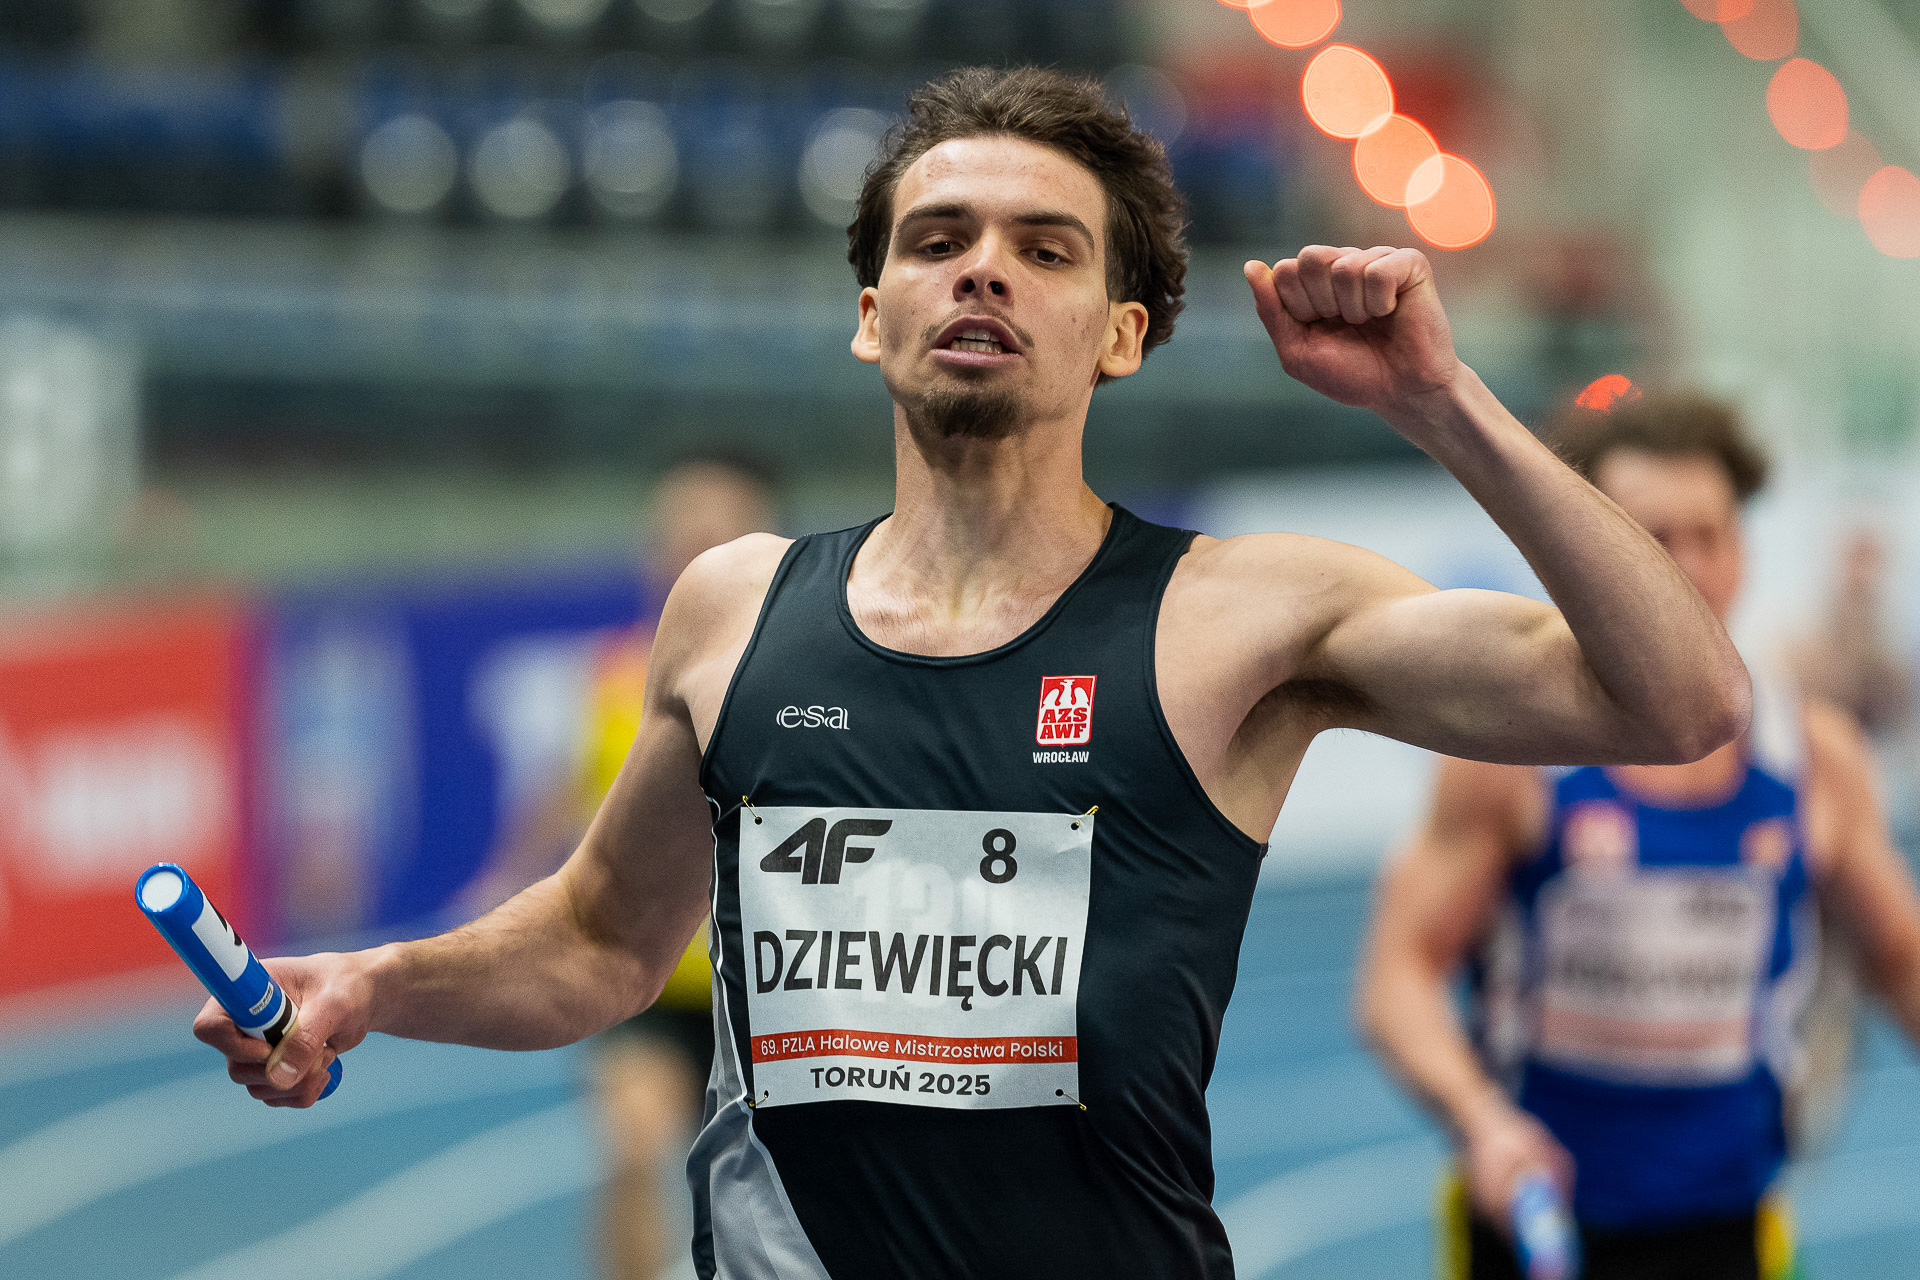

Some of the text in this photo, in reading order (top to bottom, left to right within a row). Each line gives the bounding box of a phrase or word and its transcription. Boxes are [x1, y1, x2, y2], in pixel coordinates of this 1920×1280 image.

[775, 705, 851, 730] esa
[1041, 707, 1088, 724] AZS
[1039, 723, 1087, 739] AWF
[1032, 751, 1090, 764] WROCŁAW
[759, 817, 893, 885] 4F
[979, 828, 1018, 884] 8
[753, 929, 1068, 1012] DZIEWIĘCKI
[761, 1034, 1063, 1058] 69. PZLA Halowe Mistrzostwa Polski
[810, 1064, 991, 1095] TORUŃ 2025
